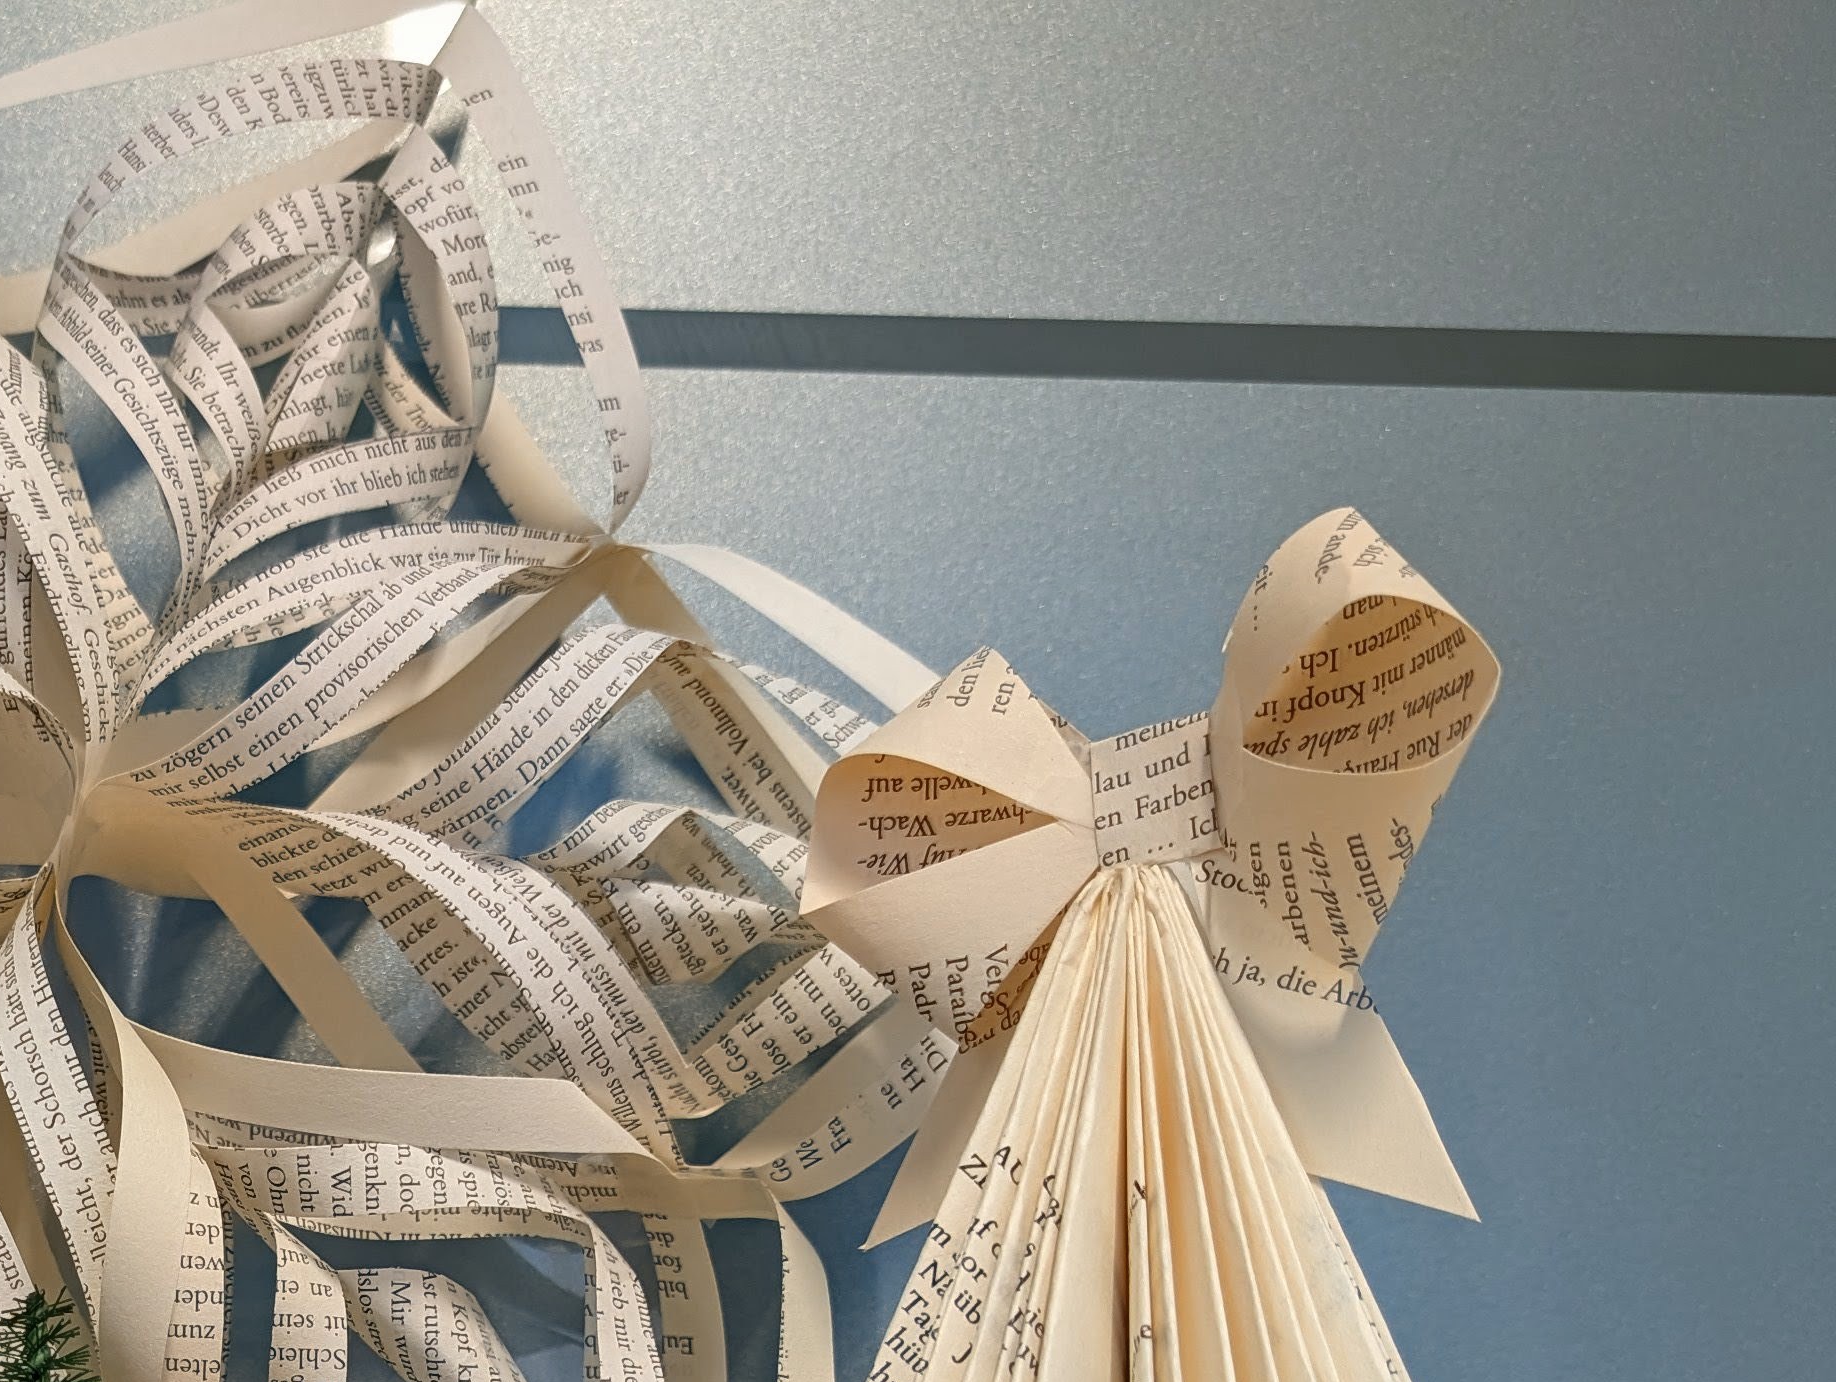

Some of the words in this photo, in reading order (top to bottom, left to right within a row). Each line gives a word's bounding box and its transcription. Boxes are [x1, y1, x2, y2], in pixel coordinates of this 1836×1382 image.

[81, 338, 116, 378] seiner
[112, 374, 183, 489] Gesichtszüge
[364, 434, 409, 460] nicht
[230, 501, 292, 539] Dicht
[297, 488, 327, 510] vor
[332, 478, 359, 499] ihr
[363, 468, 404, 493] blieb
[22, 478, 52, 521] zum
[49, 533, 91, 615] Gasthof.
[84, 628, 106, 744] Geschickt
[177, 599, 259, 656] nächsten
[264, 555, 385, 602] Augenblick
[391, 550, 424, 569] war
[1299, 648, 1340, 675] Ich
[1348, 615, 1423, 654] stürzten.
[160, 727, 232, 777] zögern
[235, 685, 296, 731] seinen
[293, 595, 383, 679] Strickschal
[187, 752, 244, 794] selbst
[247, 714, 303, 758] einen
[303, 600, 425, 721] provisorischen
[413, 561, 479, 619] Verband
[1281, 684, 1367, 717] Knopf
[1371, 672, 1404, 693] mit
[420, 781, 471, 817] seine
[472, 724, 533, 787] Hände
[532, 707, 552, 727] in
[549, 686, 579, 716] den
[575, 646, 614, 693] dicken
[681, 671, 749, 756] Vollmond
[1367, 712, 1396, 739] ich
[428, 785, 519, 843] wärmen.
[517, 733, 569, 786] Dann
[568, 710, 605, 747] sagte
[1145, 748, 1192, 779] und
[1407, 743, 1442, 764] Rue
[864, 776, 904, 799] auf
[1133, 779, 1214, 821] Farben
[857, 815, 934, 840] Wach-
[857, 855, 910, 875] Wie-
[1344, 834, 1389, 923] meinem
[468, 886, 527, 946] Augen
[526, 947, 553, 979] die
[1232, 957, 1265, 987] ja,
[1276, 965, 1317, 996] die
[574, 1011, 615, 1077] schlug
[14, 1030, 64, 1128] Schorsch
[167, 1323, 215, 1338] zum
